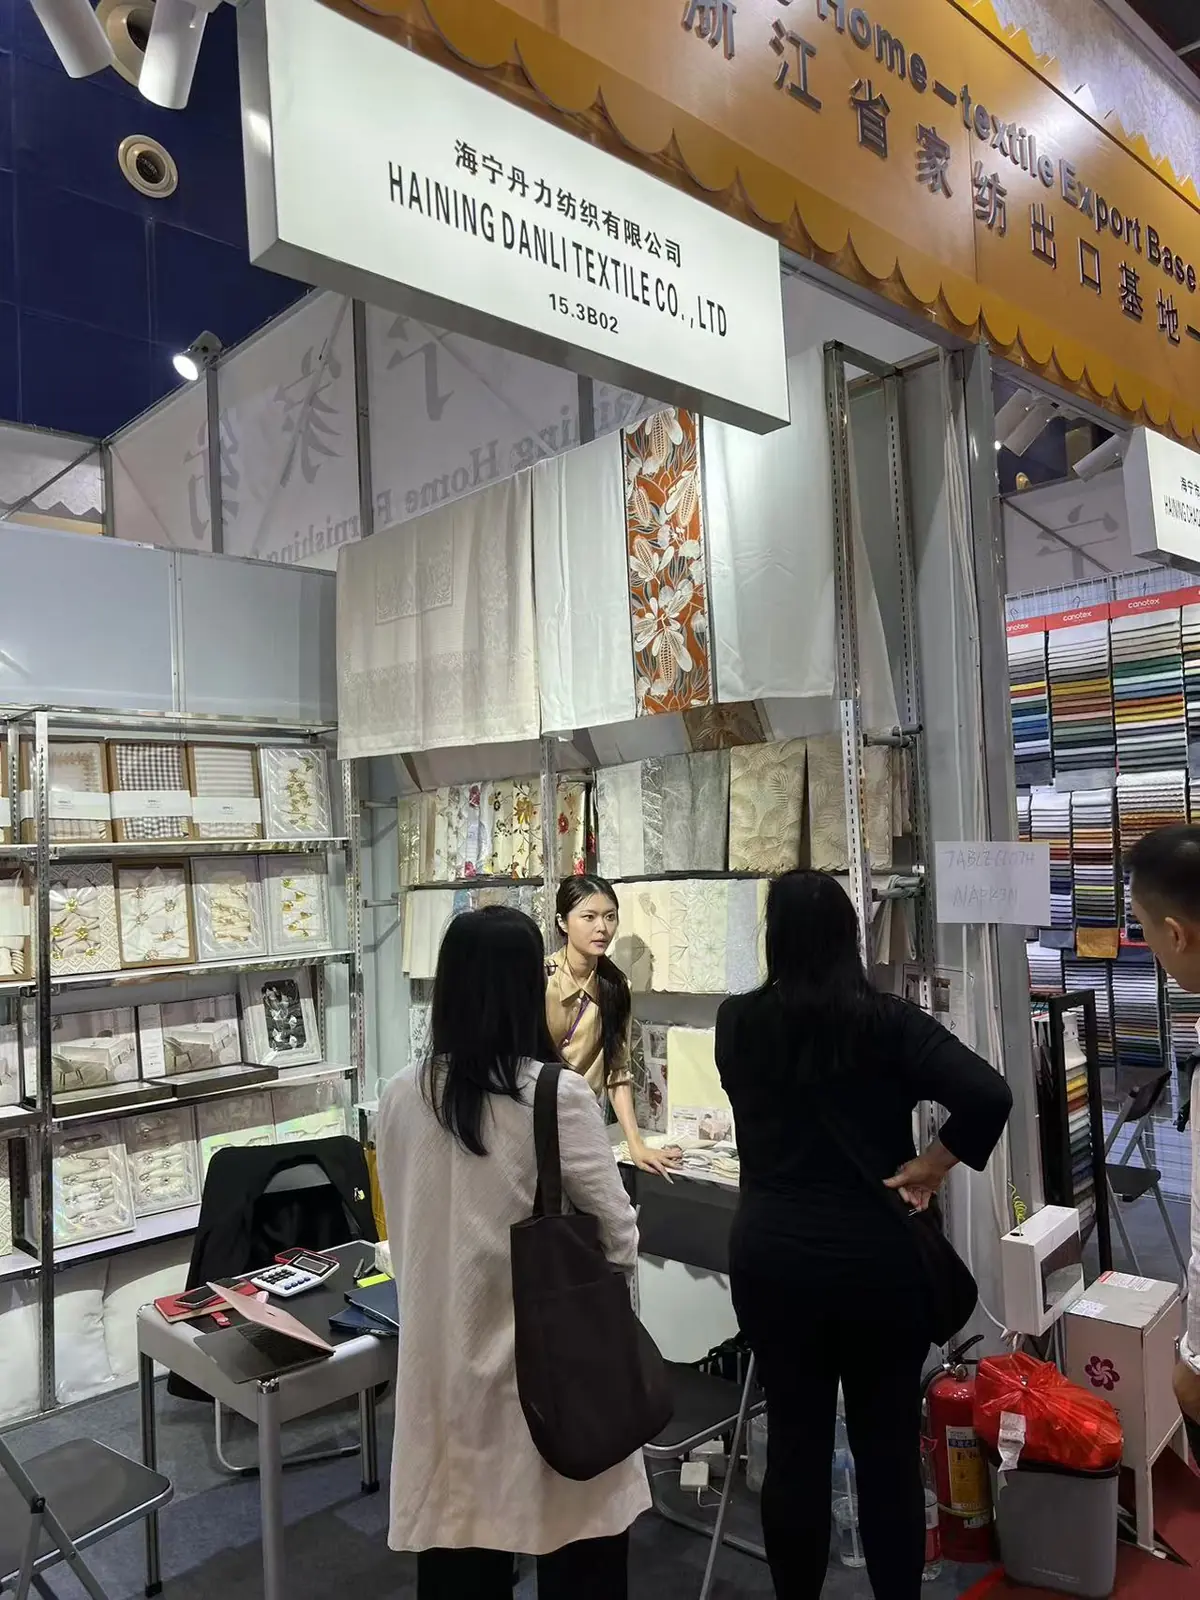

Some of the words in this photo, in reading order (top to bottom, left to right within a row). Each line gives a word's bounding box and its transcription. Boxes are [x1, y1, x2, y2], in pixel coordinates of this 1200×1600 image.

[387, 160, 495, 244] HAINING
[502, 210, 568, 273] DANLI
[571, 240, 651, 307] TEXTILE
[454, 138, 683, 268] 海宁丹力纺织有限公司
[1059, 158, 1142, 254] Export
[1146, 224, 1197, 293] Base
[548, 292, 619, 334] 15.3B02
